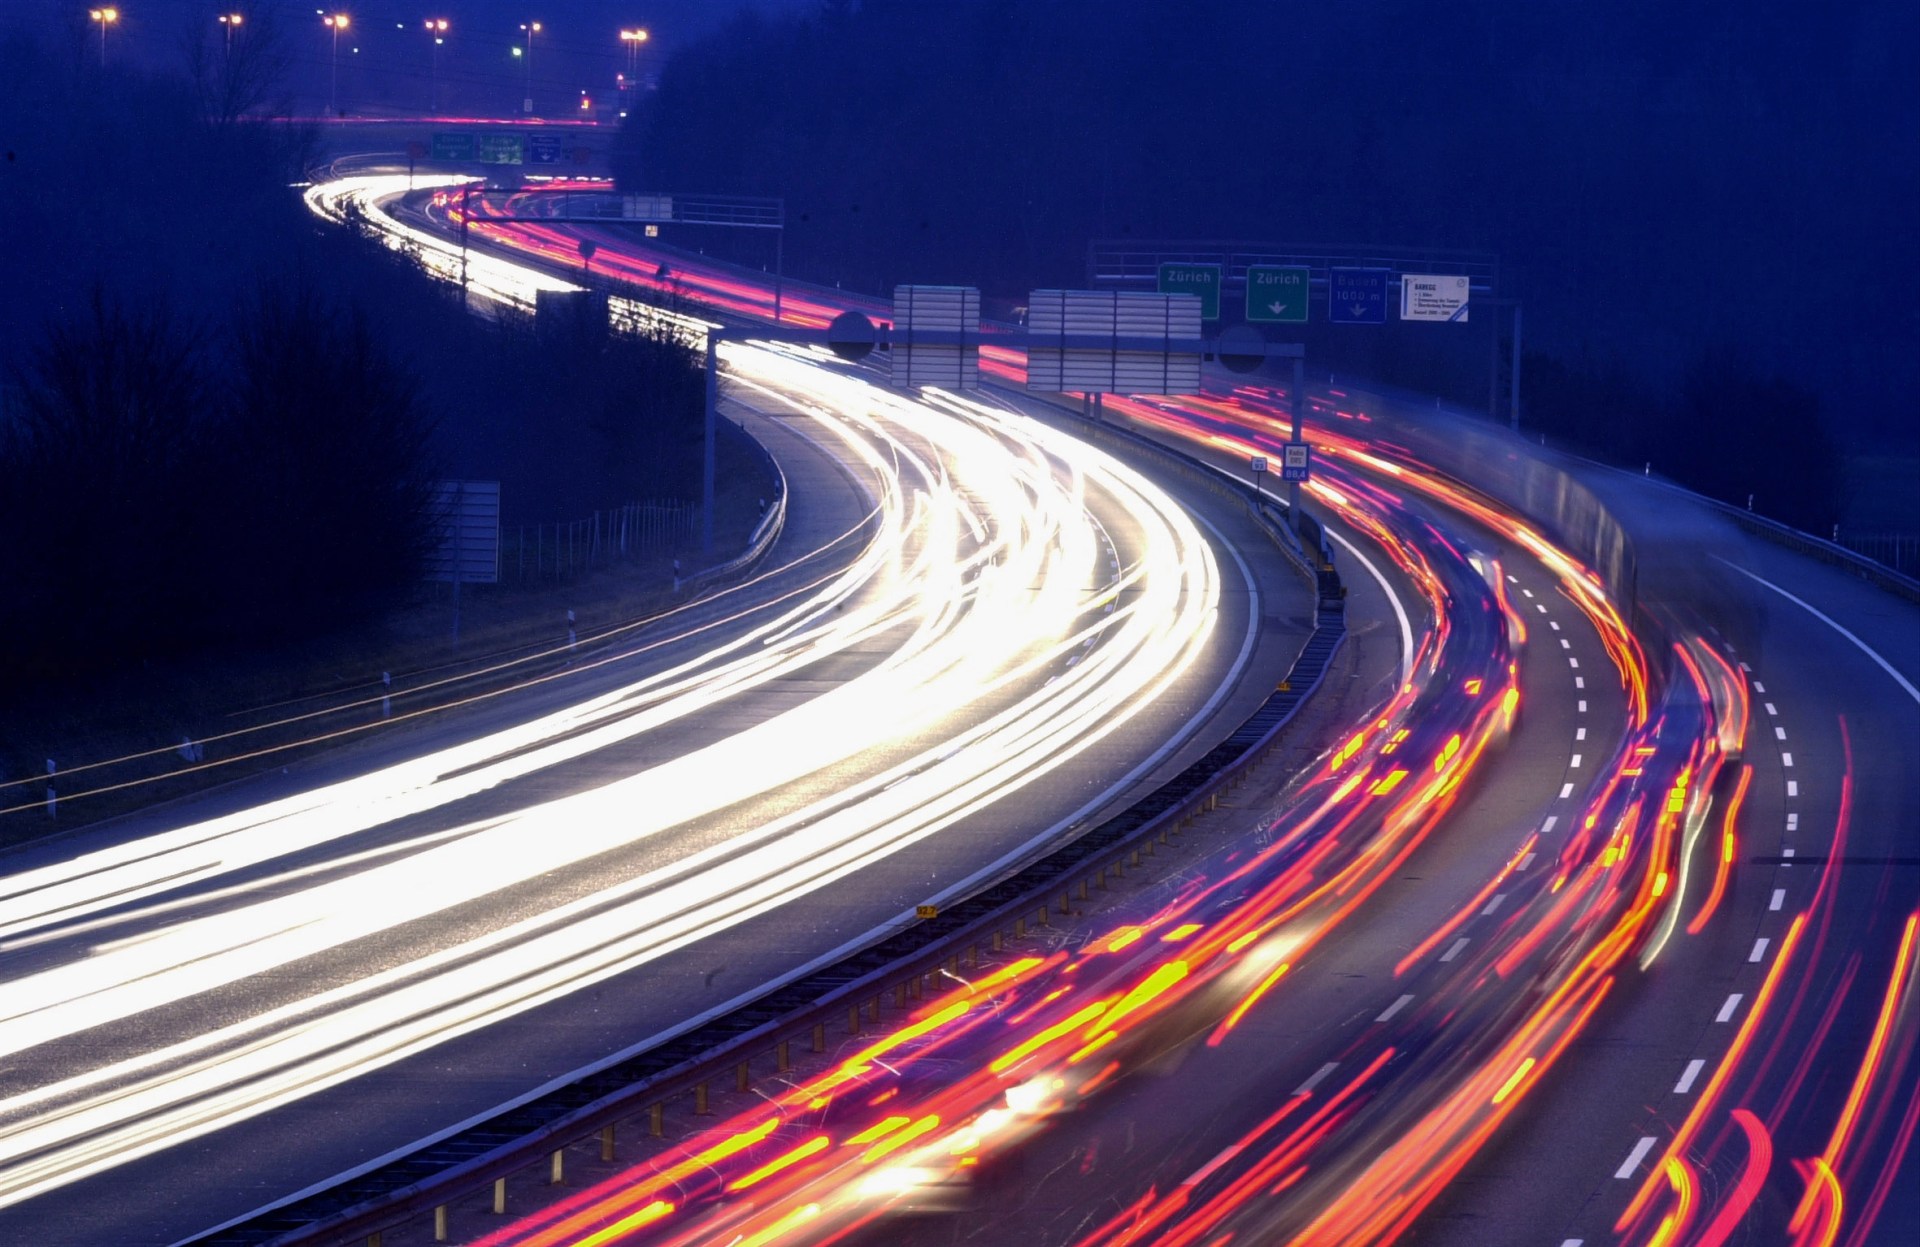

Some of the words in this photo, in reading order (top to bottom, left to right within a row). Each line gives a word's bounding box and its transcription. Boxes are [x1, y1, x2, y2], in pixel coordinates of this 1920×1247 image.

[1168, 270, 1211, 282] Zürich
[1257, 272, 1300, 284] Zürich
[1338, 275, 1378, 286] Baden
[1337, 290, 1365, 301] 1000
[1370, 293, 1380, 301] m
